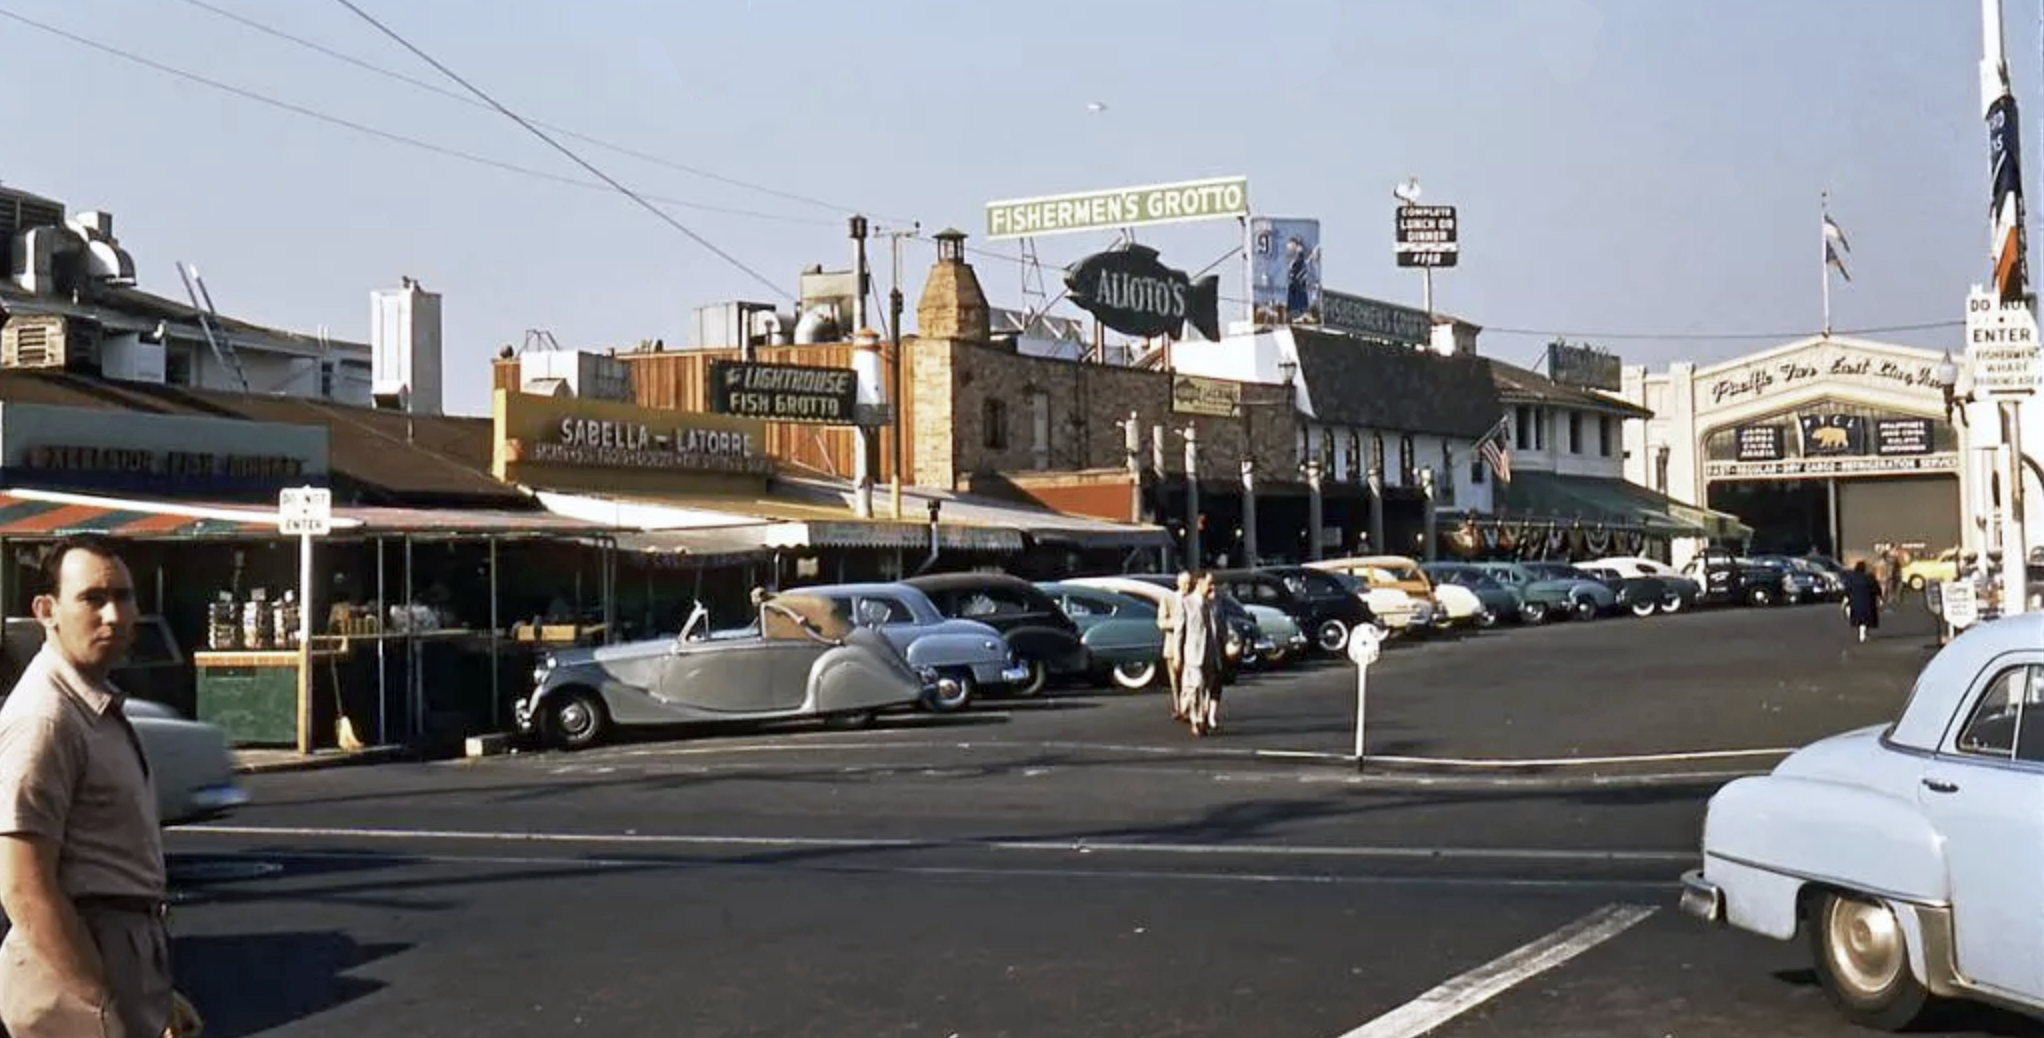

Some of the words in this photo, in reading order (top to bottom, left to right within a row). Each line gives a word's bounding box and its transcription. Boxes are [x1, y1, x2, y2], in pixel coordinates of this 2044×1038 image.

[991, 191, 1139, 234] FISHERMEN'S
[1147, 184, 1243, 216] GROTTO
[1401, 218, 1436, 229] LUNCH
[1097, 269, 1186, 317] ALIOTO'S
[1971, 299, 1991, 312] DO
[1973, 328, 2032, 342] ENTER
[745, 367, 849, 393] LIGHTHOUSE
[730, 393, 769, 413] FISH
[775, 394, 840, 417] GROTTO
[561, 418, 649, 450] SABELLA
[676, 428, 754, 457] LATORRE
[285, 518, 323, 530] ENTER
